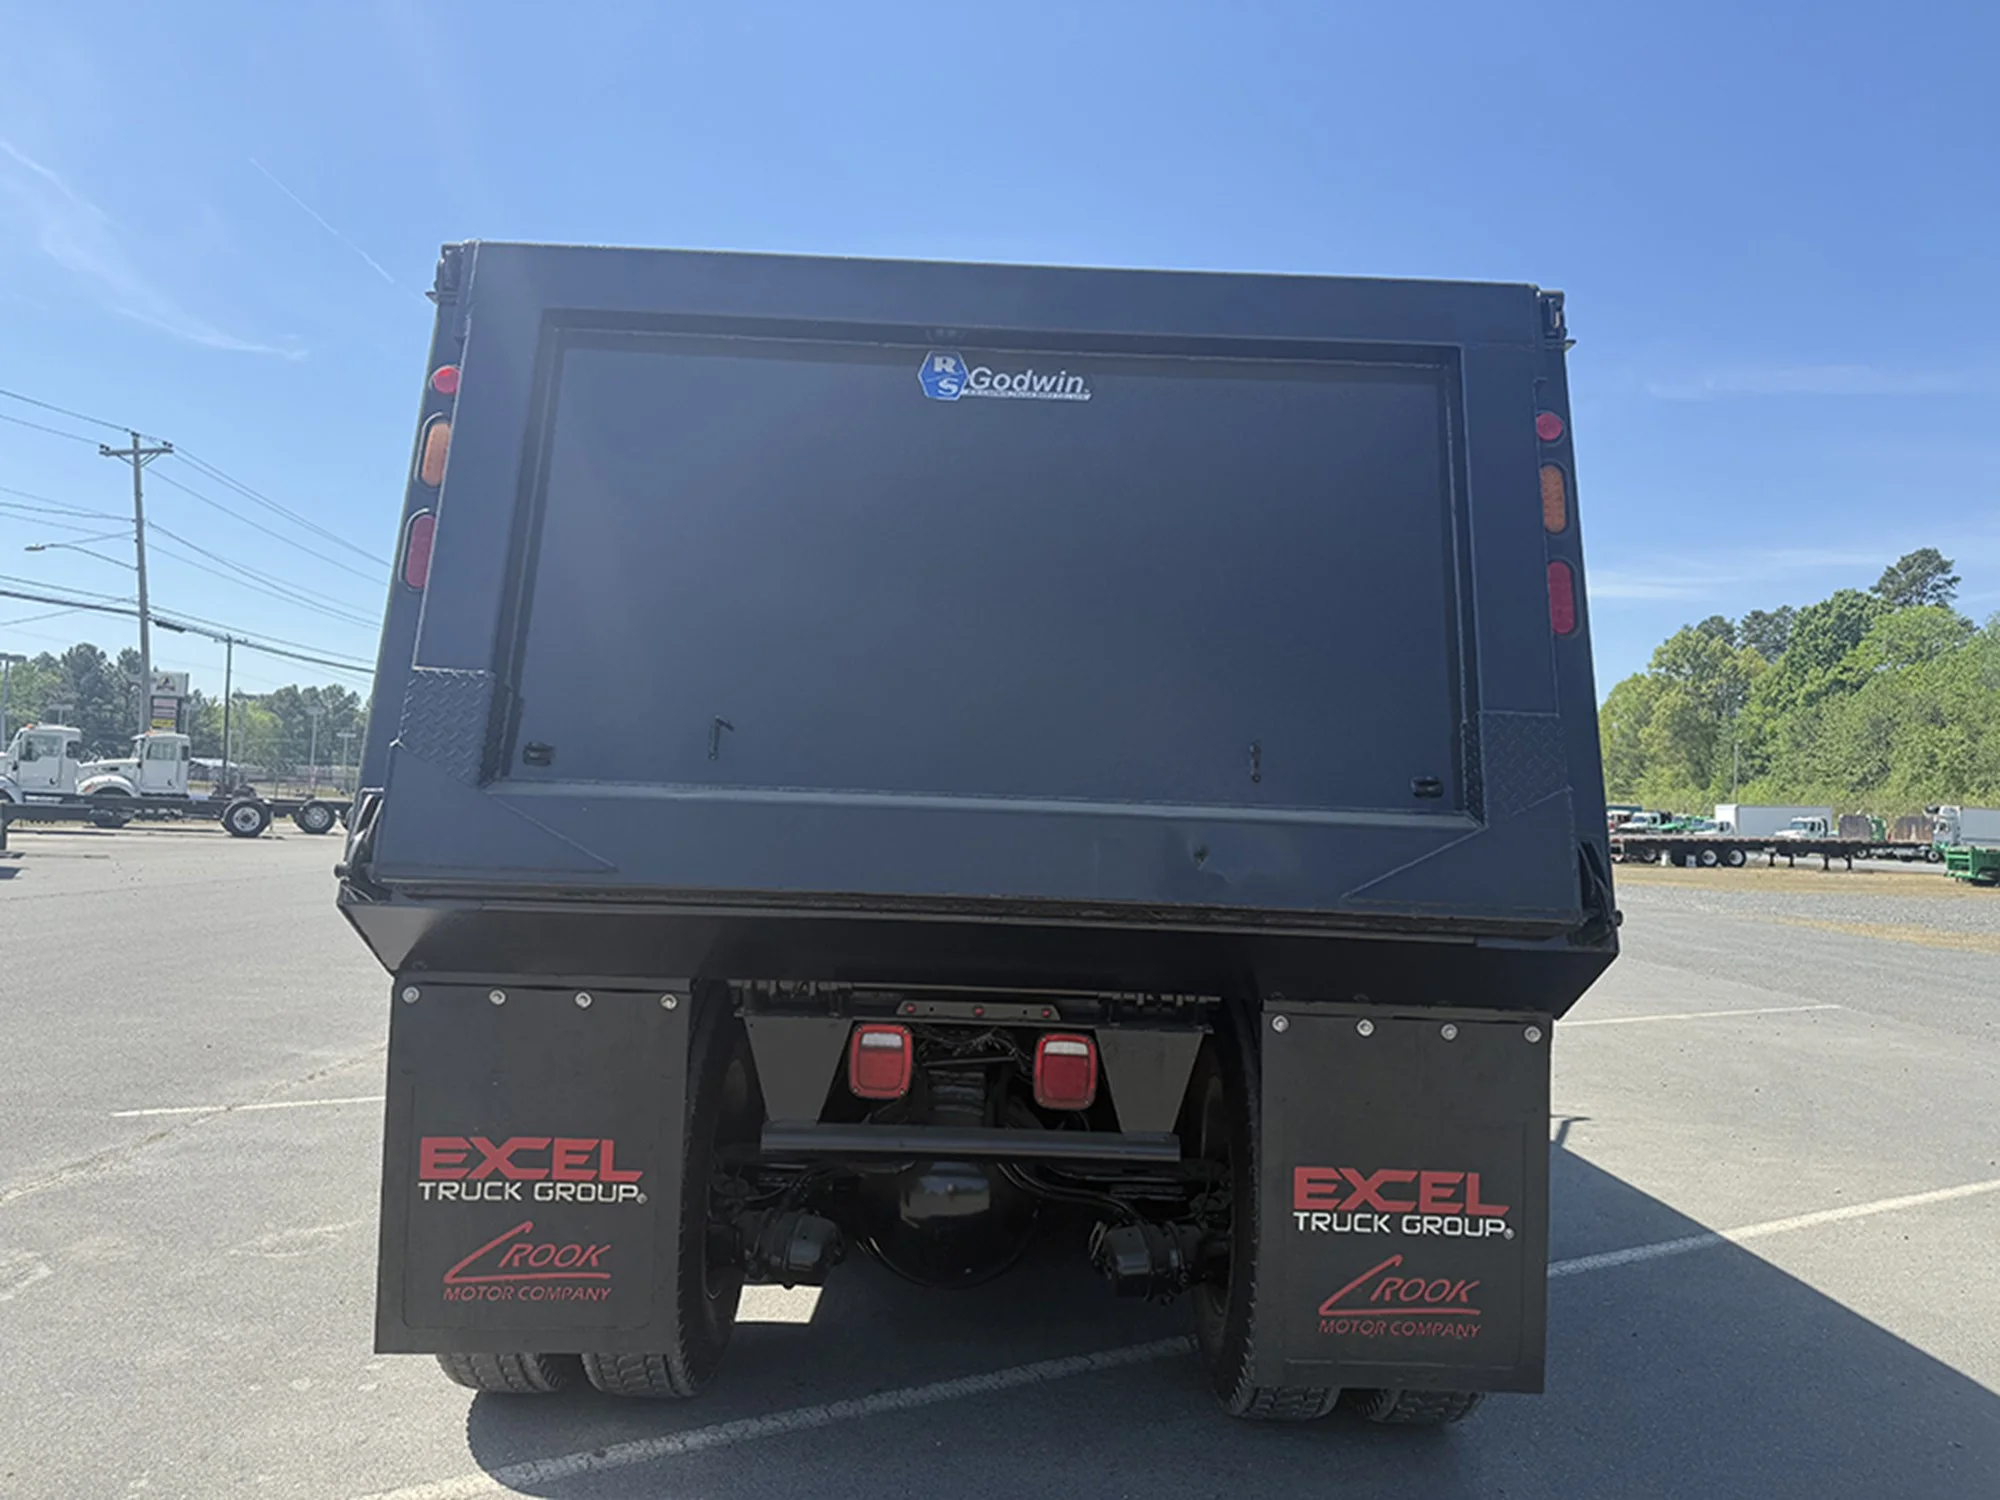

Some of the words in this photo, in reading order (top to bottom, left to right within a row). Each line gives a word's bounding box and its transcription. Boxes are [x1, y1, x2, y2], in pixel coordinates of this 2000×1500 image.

[969, 366, 1084, 393] Godwin
[419, 1136, 643, 1182] EXCEL
[418, 1181, 522, 1201] TRUCK
[1293, 1166, 1510, 1216] EXCEL
[1293, 1212, 1391, 1234] TRUCK
[443, 1286, 514, 1301] MOTOR
[517, 1286, 612, 1301] COMPANY
[1318, 1319, 1387, 1336] MOTOR
[1389, 1320, 1481, 1338] COMPANY
